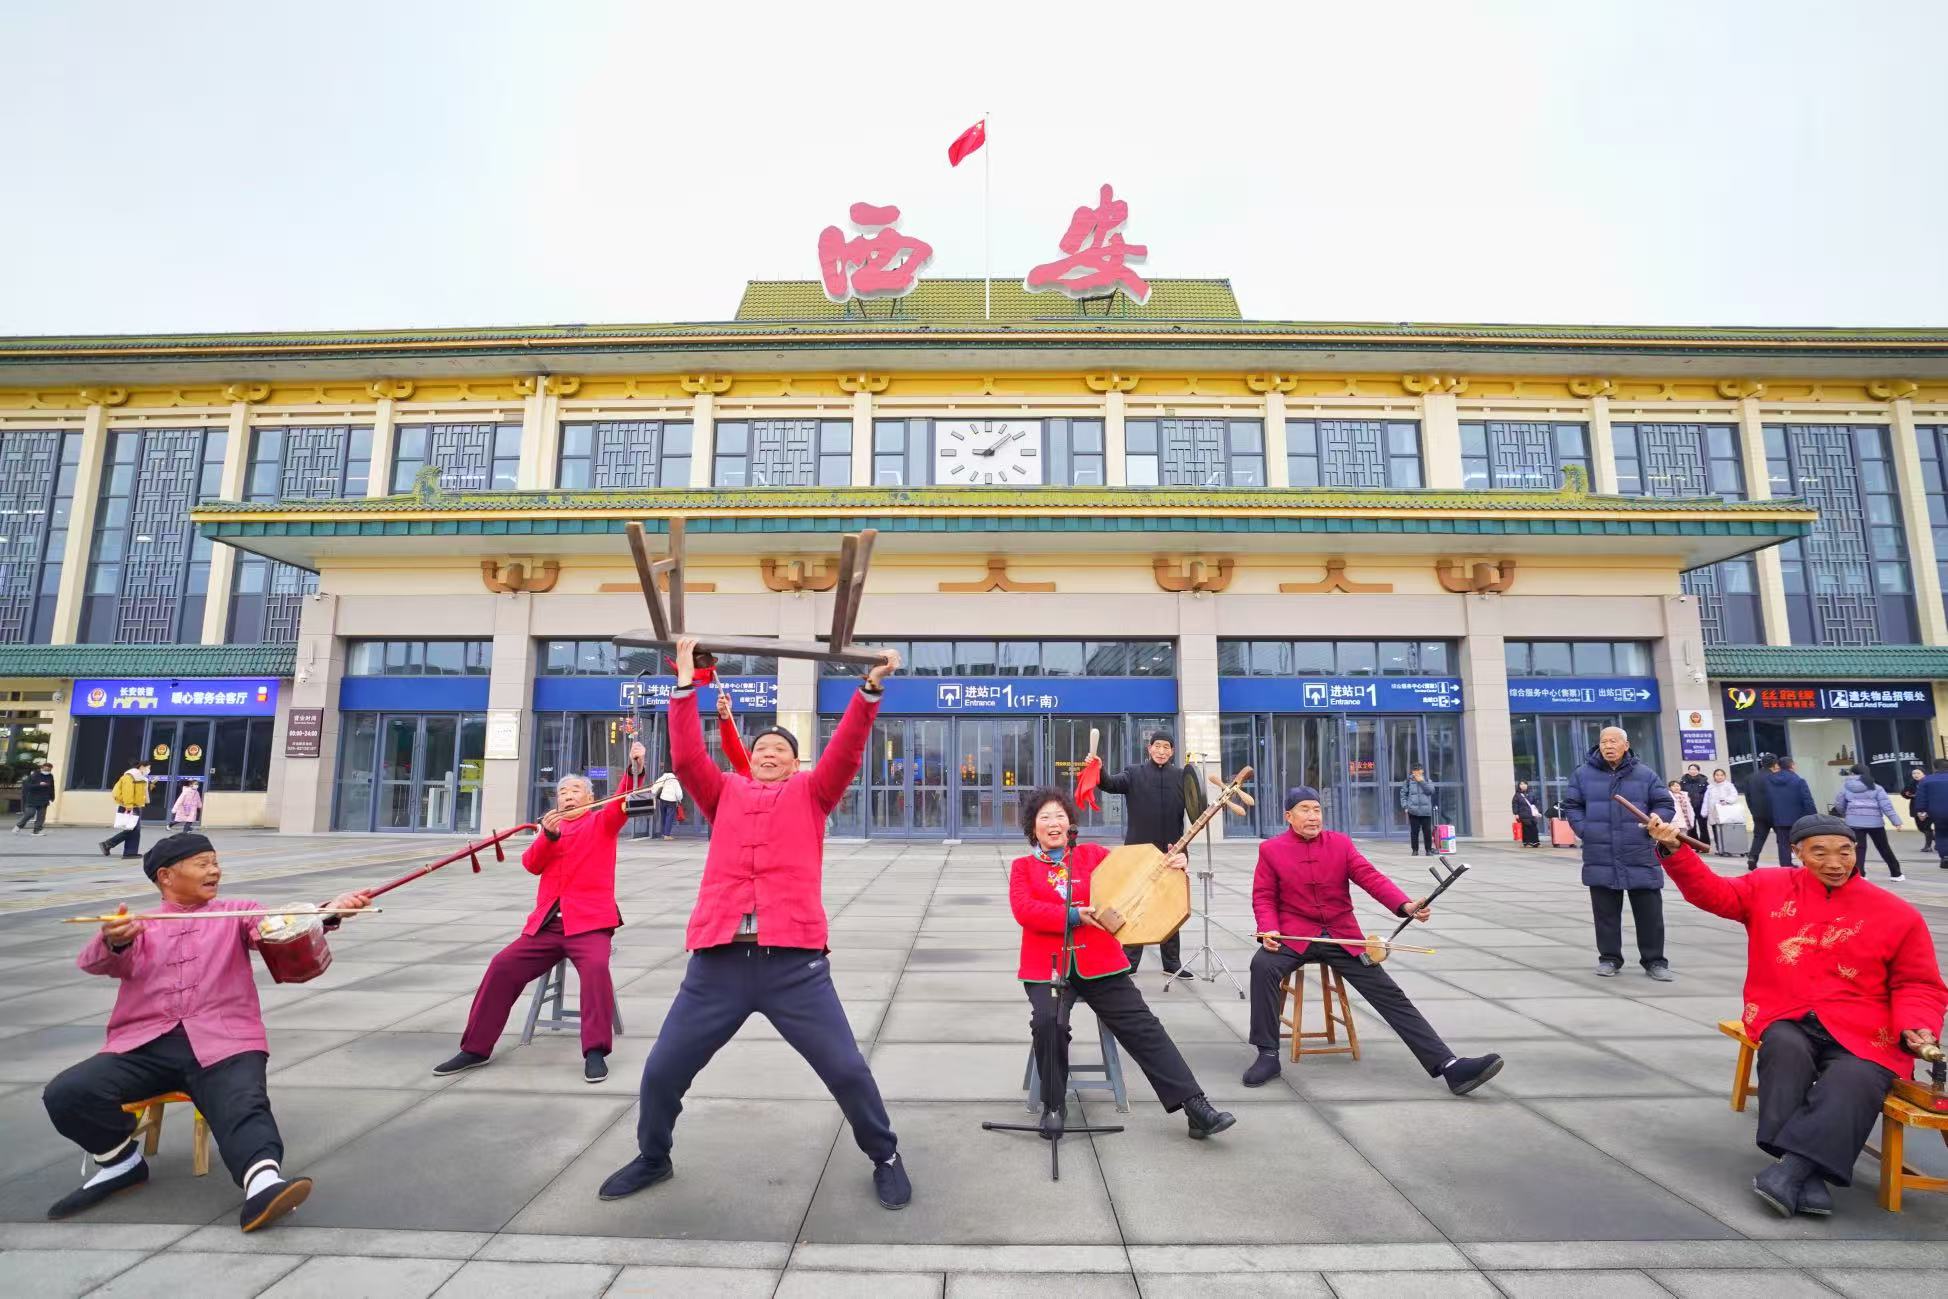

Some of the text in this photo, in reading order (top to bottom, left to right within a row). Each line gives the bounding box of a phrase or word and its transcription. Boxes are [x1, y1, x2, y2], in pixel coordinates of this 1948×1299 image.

[965, 686, 1001, 698] 进站口
[1002, 684, 1013, 708] 1
[1330, 683, 1377, 707] 进站口 1
[1598, 688, 1623, 698] 出站口
[1849, 690, 1925, 702] 遗失物品招领处
[964, 699, 996, 707] Entrance
[1330, 698, 1361, 706] Entrance
